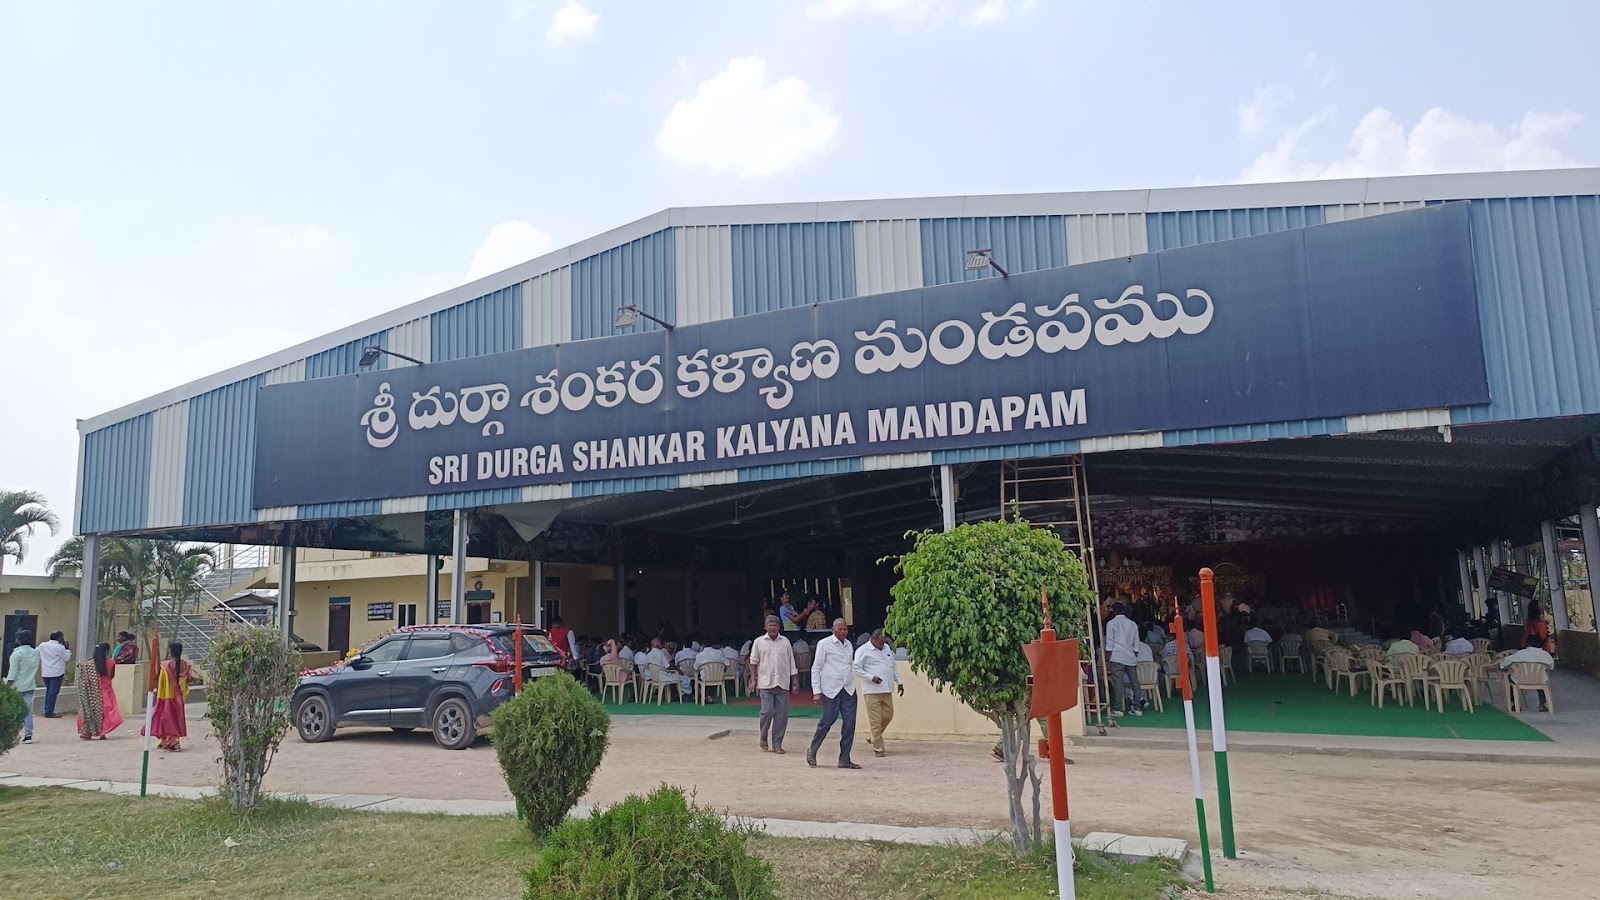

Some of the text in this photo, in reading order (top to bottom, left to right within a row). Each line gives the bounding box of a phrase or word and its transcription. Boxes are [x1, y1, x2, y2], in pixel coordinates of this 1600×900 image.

[360, 284, 1215, 449] శ్రీ దుర్గా శంకర కళ్యాణ మండపము
[428, 388, 1088, 485] SRI DURGA SHANKAR KALYANA MANDAPAM
